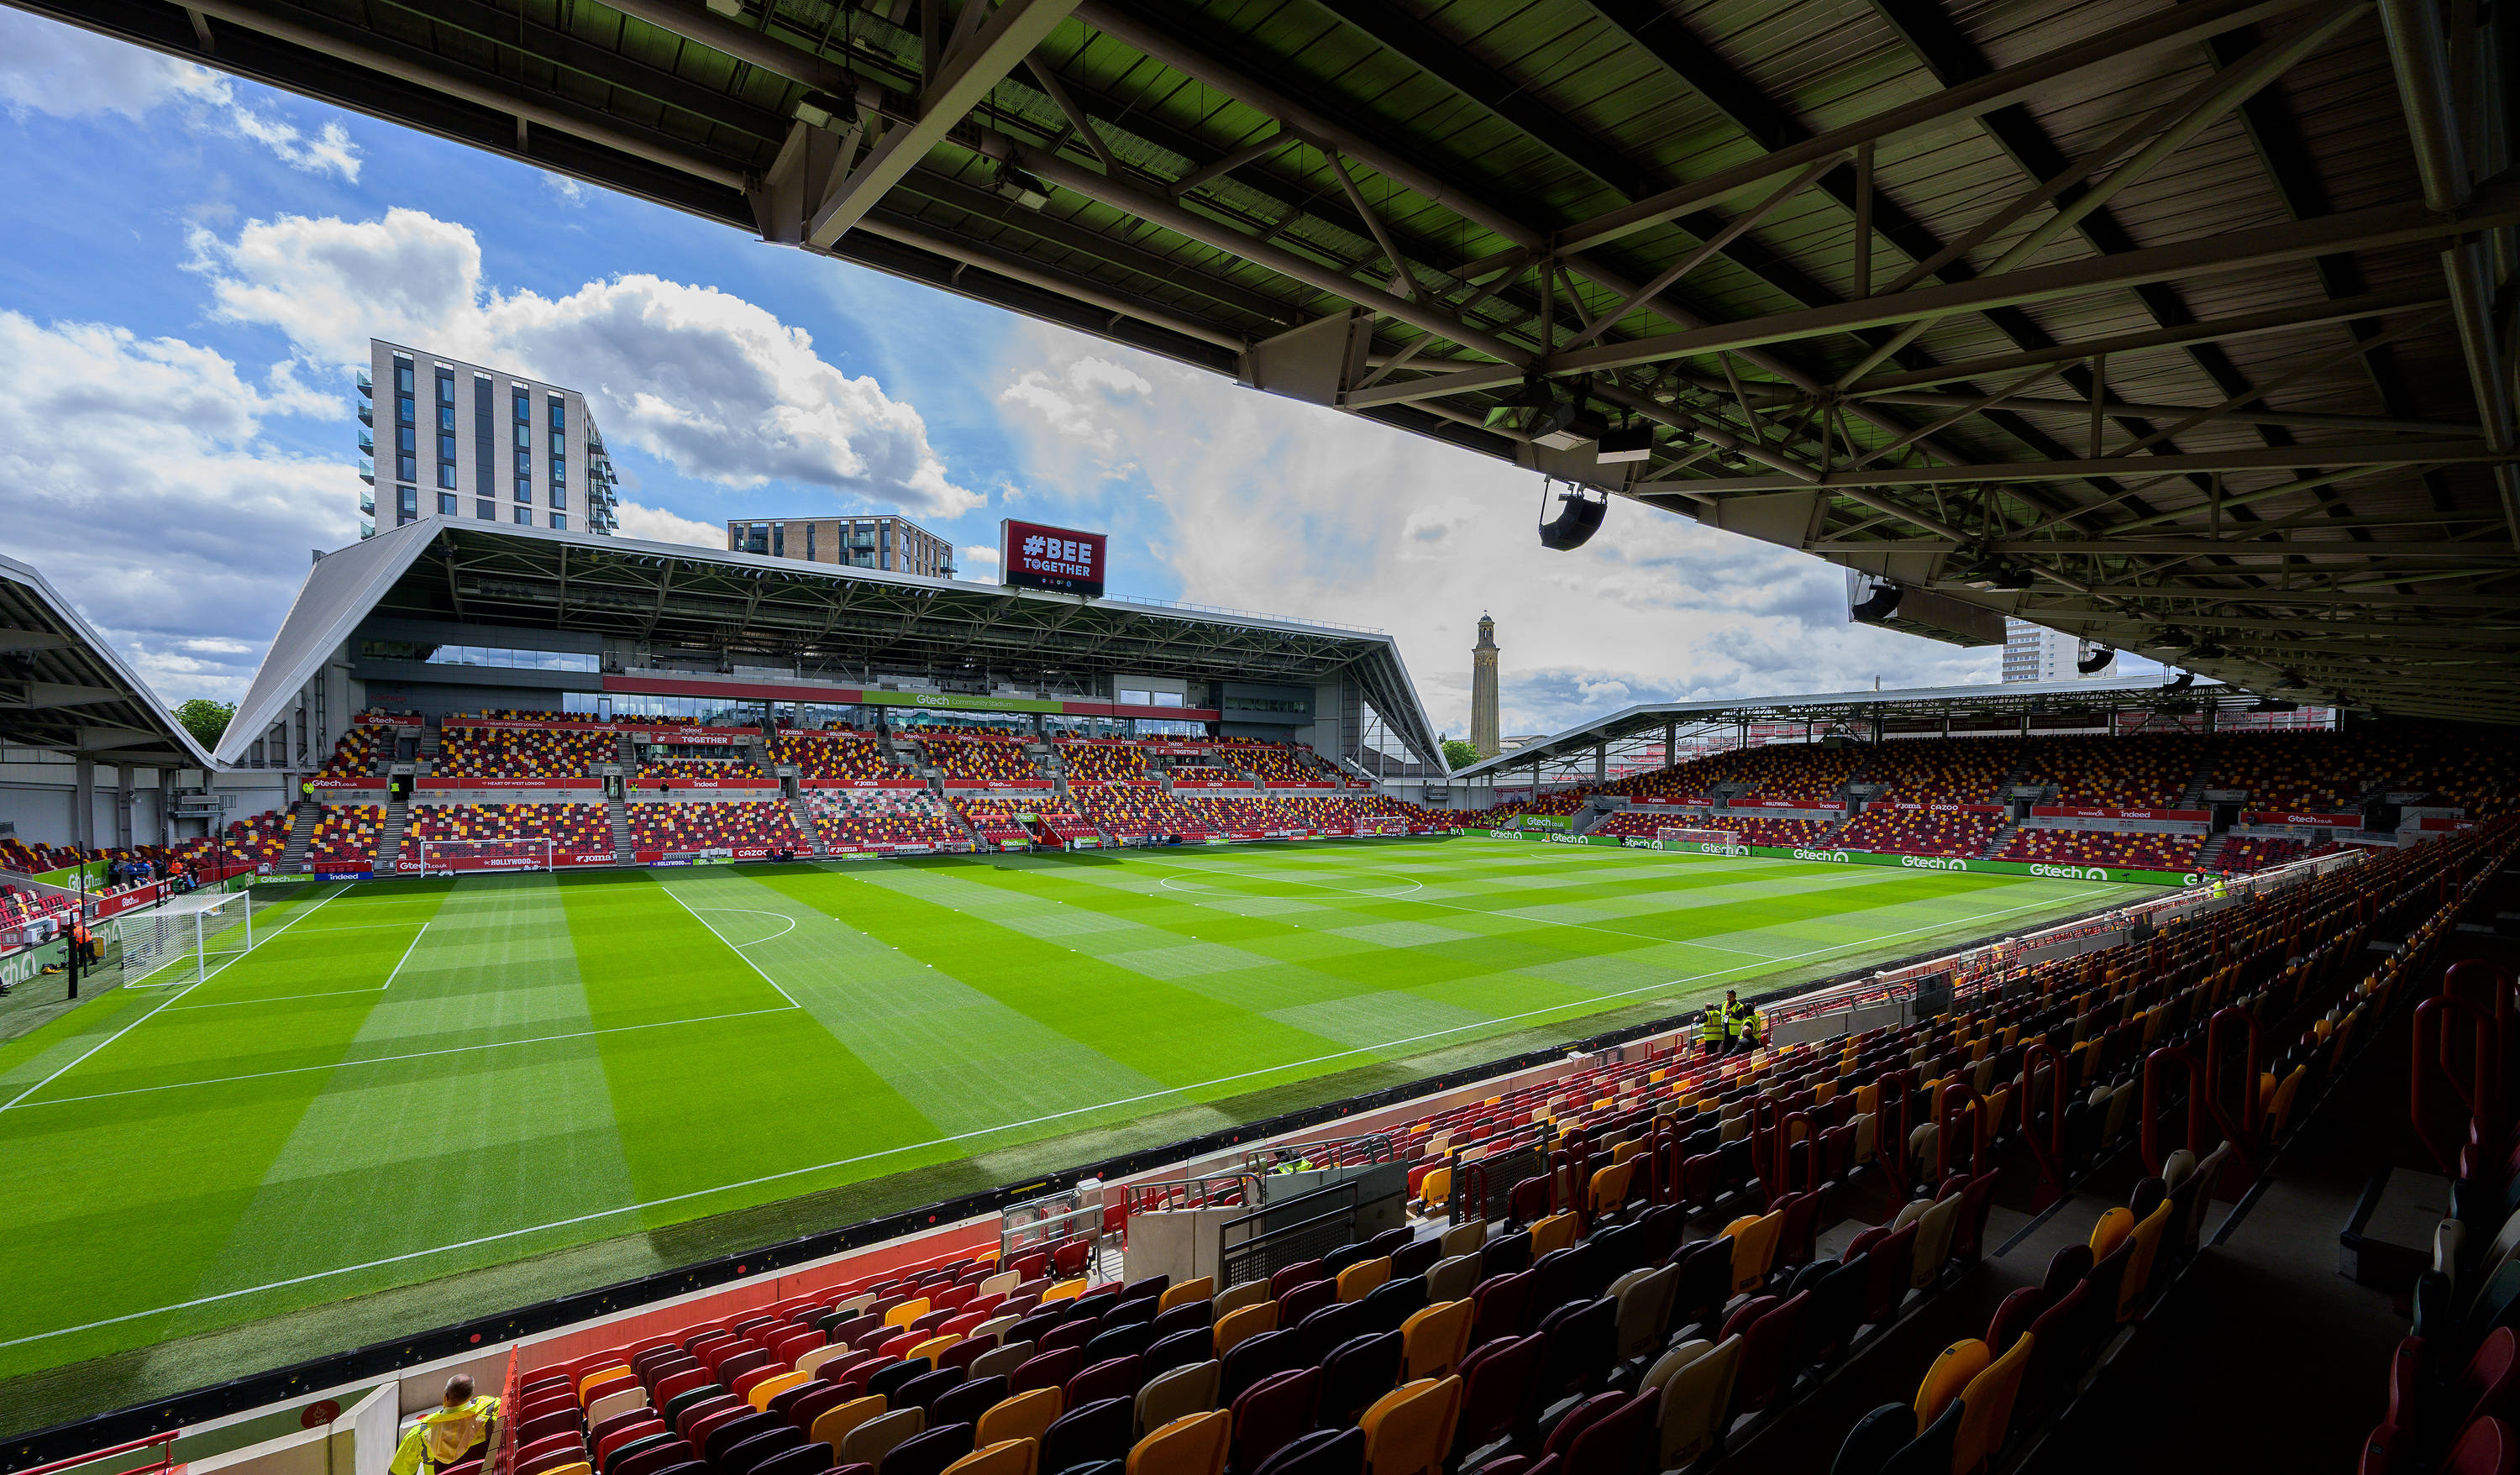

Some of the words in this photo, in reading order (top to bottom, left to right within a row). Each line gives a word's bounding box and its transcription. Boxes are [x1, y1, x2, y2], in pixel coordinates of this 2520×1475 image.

[1023, 535, 1092, 564] #BEE
[1023, 558, 1090, 577] TOGETHER
[916, 694, 949, 706] Gtech
[952, 698, 987, 707] Community
[989, 700, 1014, 708] Stadium
[1527, 816, 1565, 827] Gtechco.uk
[2287, 815, 2333, 824] Gtech.co.uk
[1490, 829, 1513, 840] Gtech
[1551, 833, 1578, 844] Gtech
[1701, 842, 1734, 854] Gtech
[1793, 848, 1831, 862] Gtech
[1902, 855, 1946, 869] Gtech
[328, 873, 360, 881] indeed
[2029, 863, 2082, 879] Gtech
